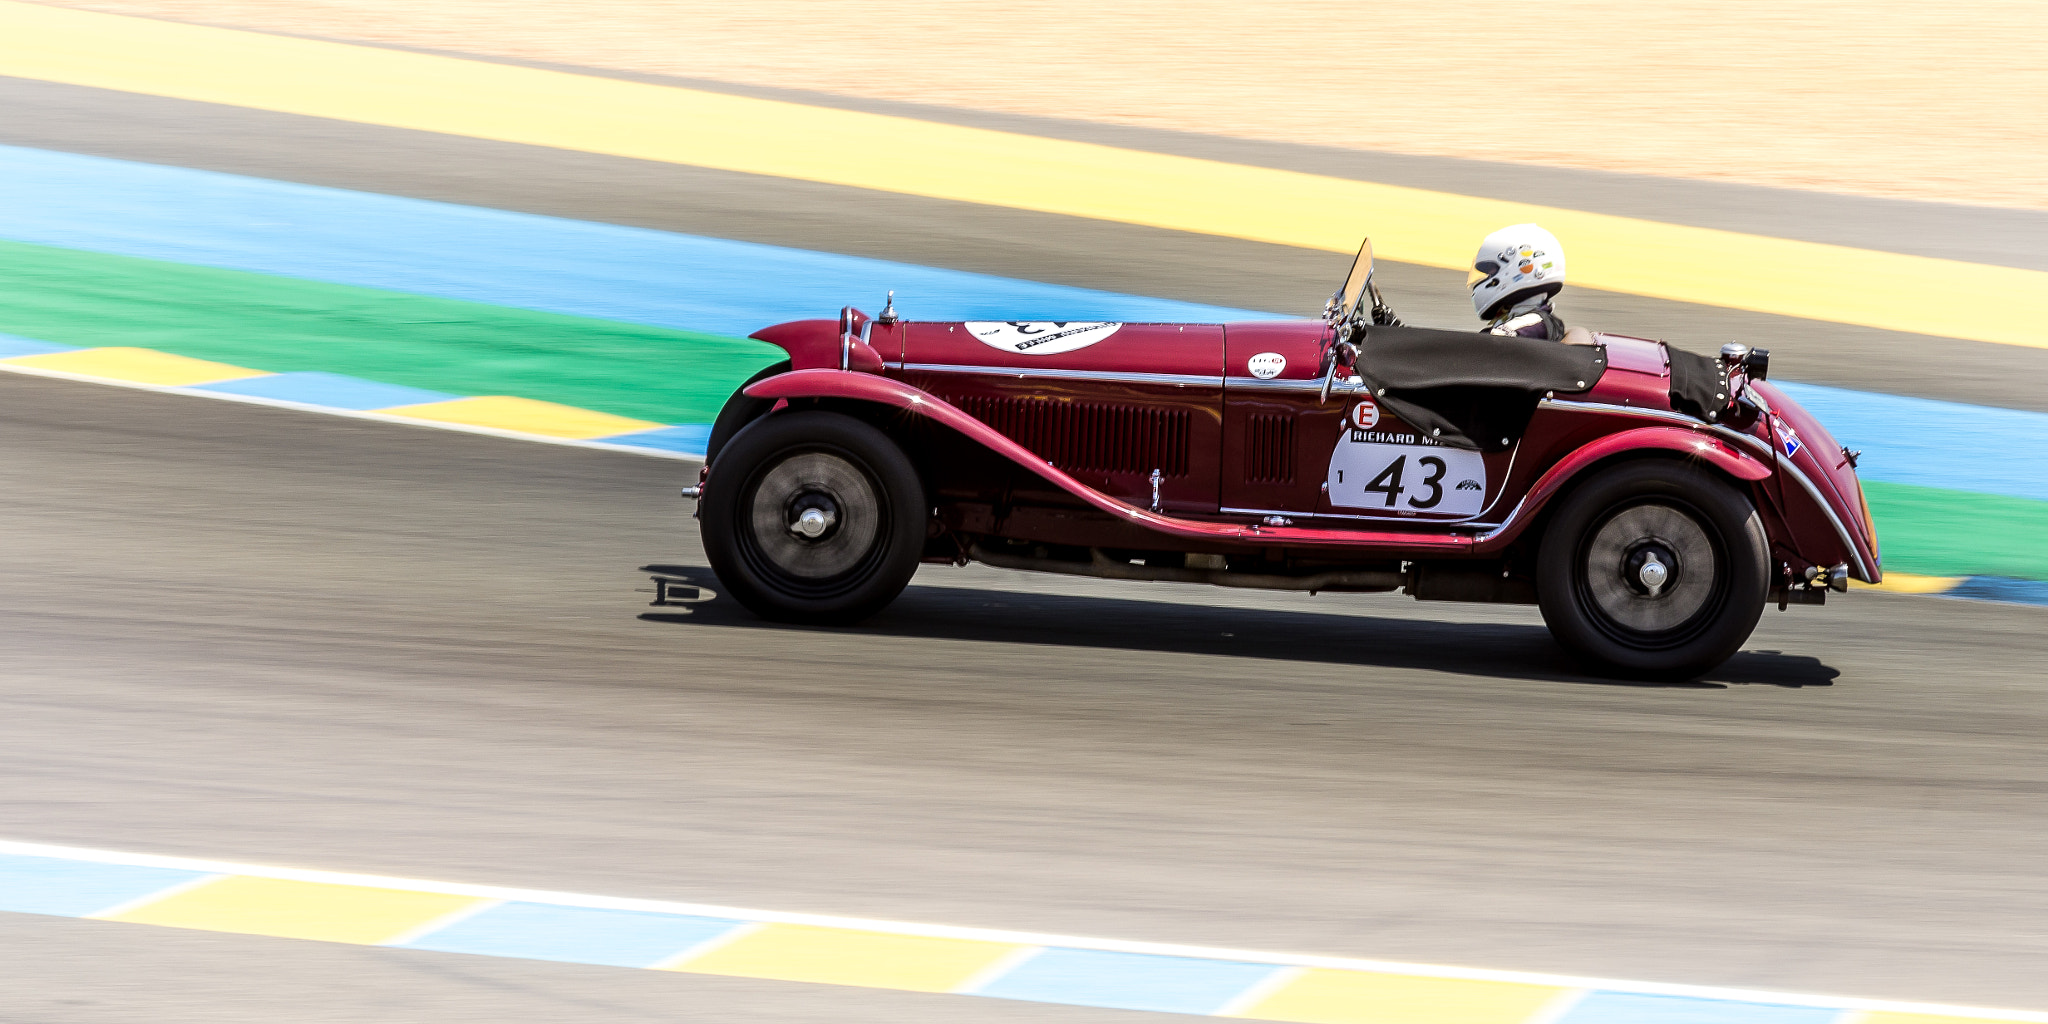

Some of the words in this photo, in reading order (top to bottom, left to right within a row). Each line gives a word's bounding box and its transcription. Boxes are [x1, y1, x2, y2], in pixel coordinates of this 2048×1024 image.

[1358, 404, 1374, 426] E
[1353, 430, 1415, 444] RICHARD
[1337, 469, 1344, 484] 1
[1364, 454, 1447, 509] 43
